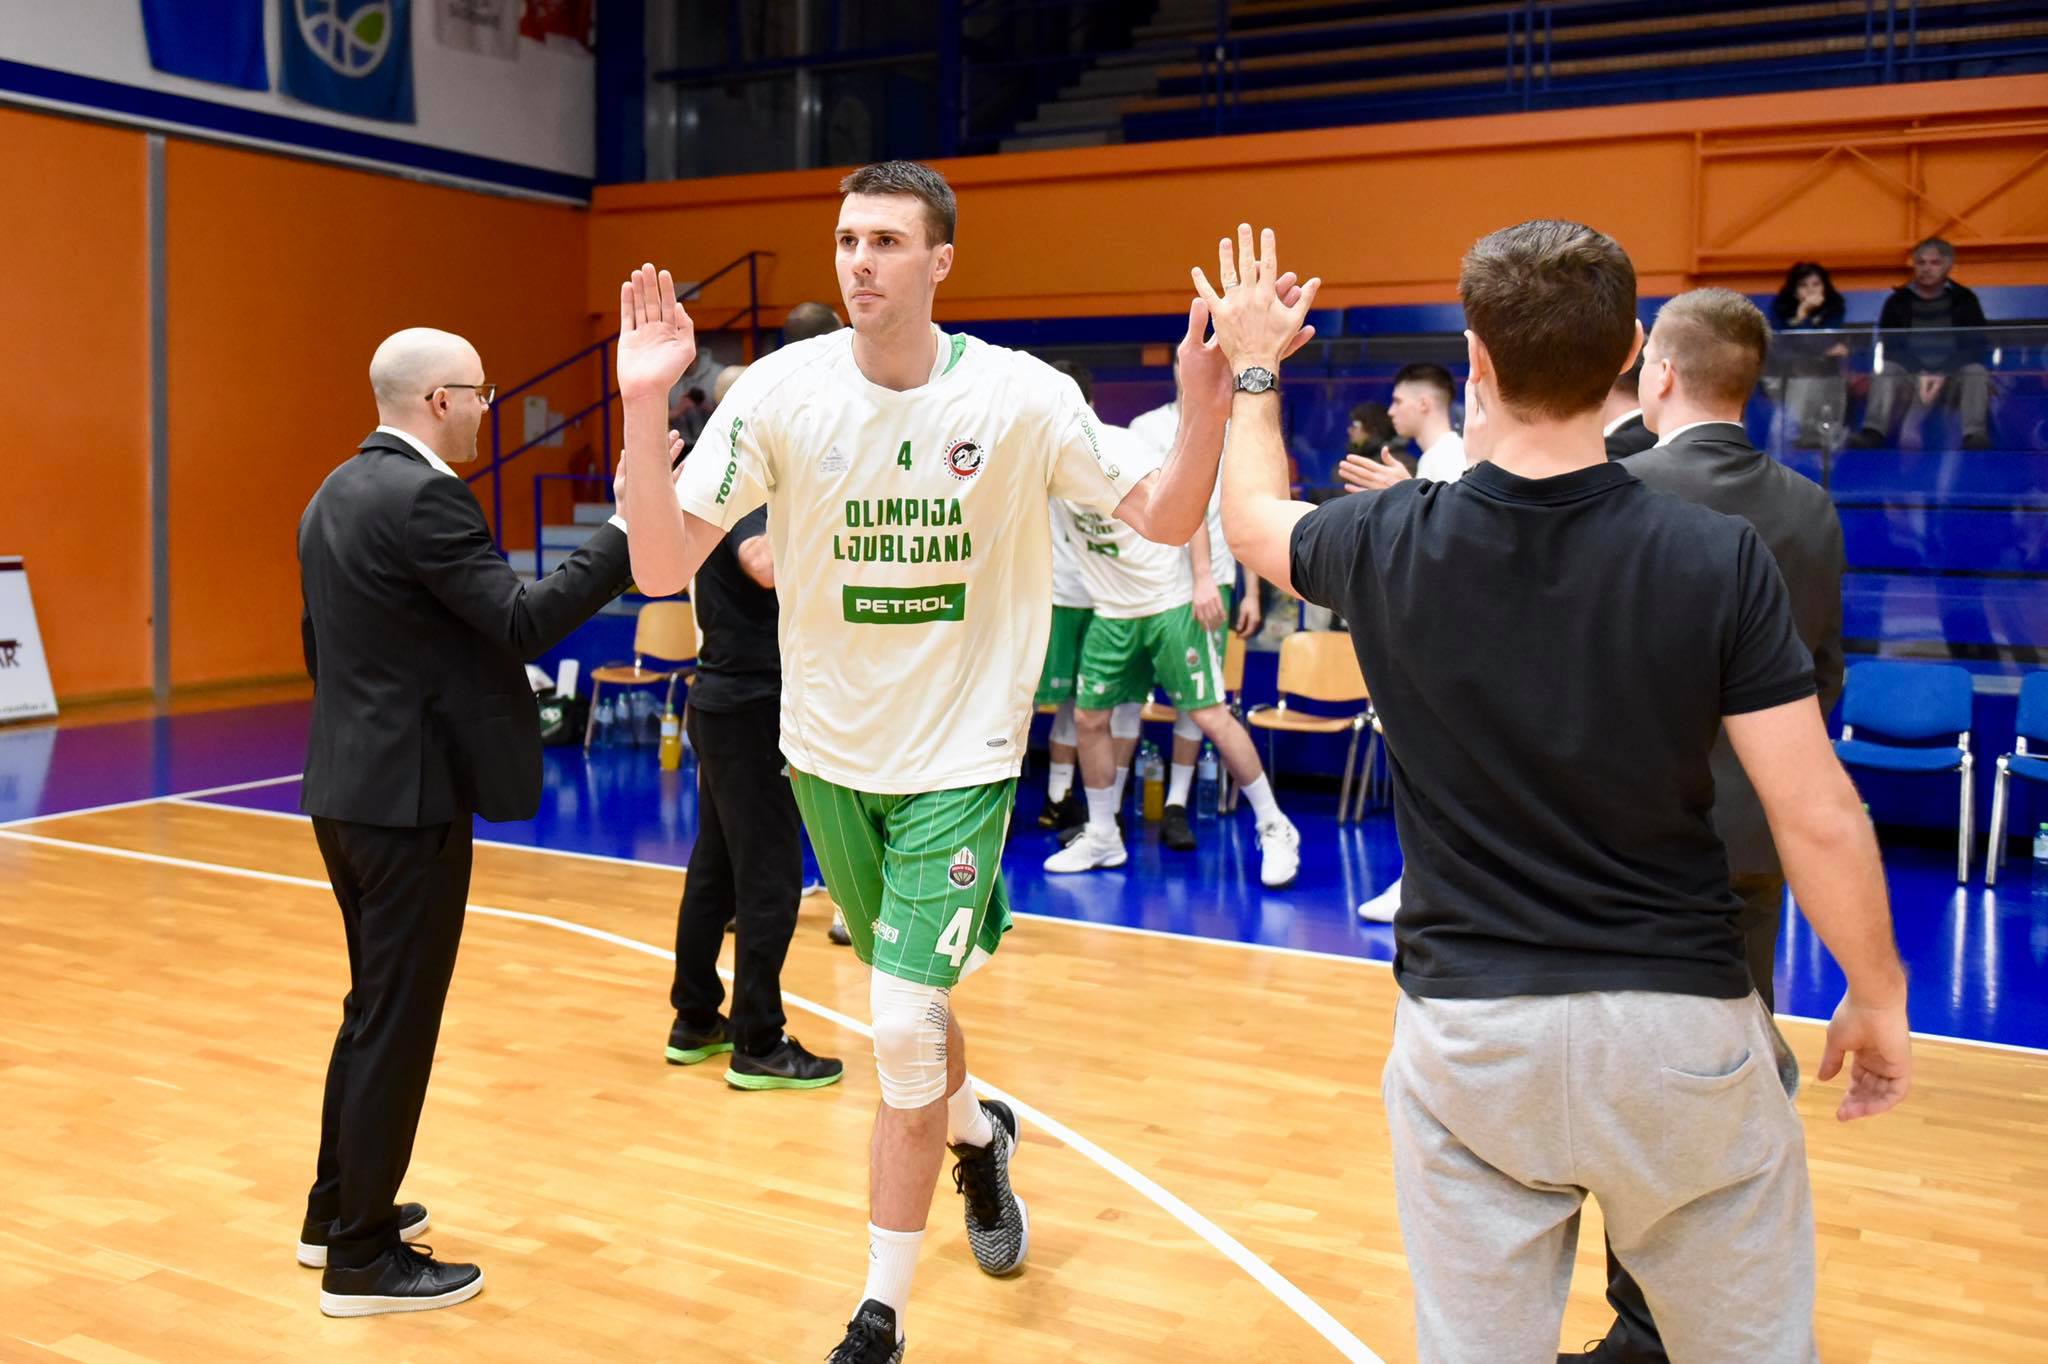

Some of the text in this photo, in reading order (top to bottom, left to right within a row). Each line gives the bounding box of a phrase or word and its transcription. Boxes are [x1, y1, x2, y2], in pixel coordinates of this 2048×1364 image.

[897, 440, 913, 471] 4
[715, 460, 737, 505] TOYO
[845, 498, 962, 527] OLIMPIJA
[834, 532, 971, 563] LJUBLJANA
[855, 596, 953, 613] PETROL
[935, 907, 976, 967] 4
